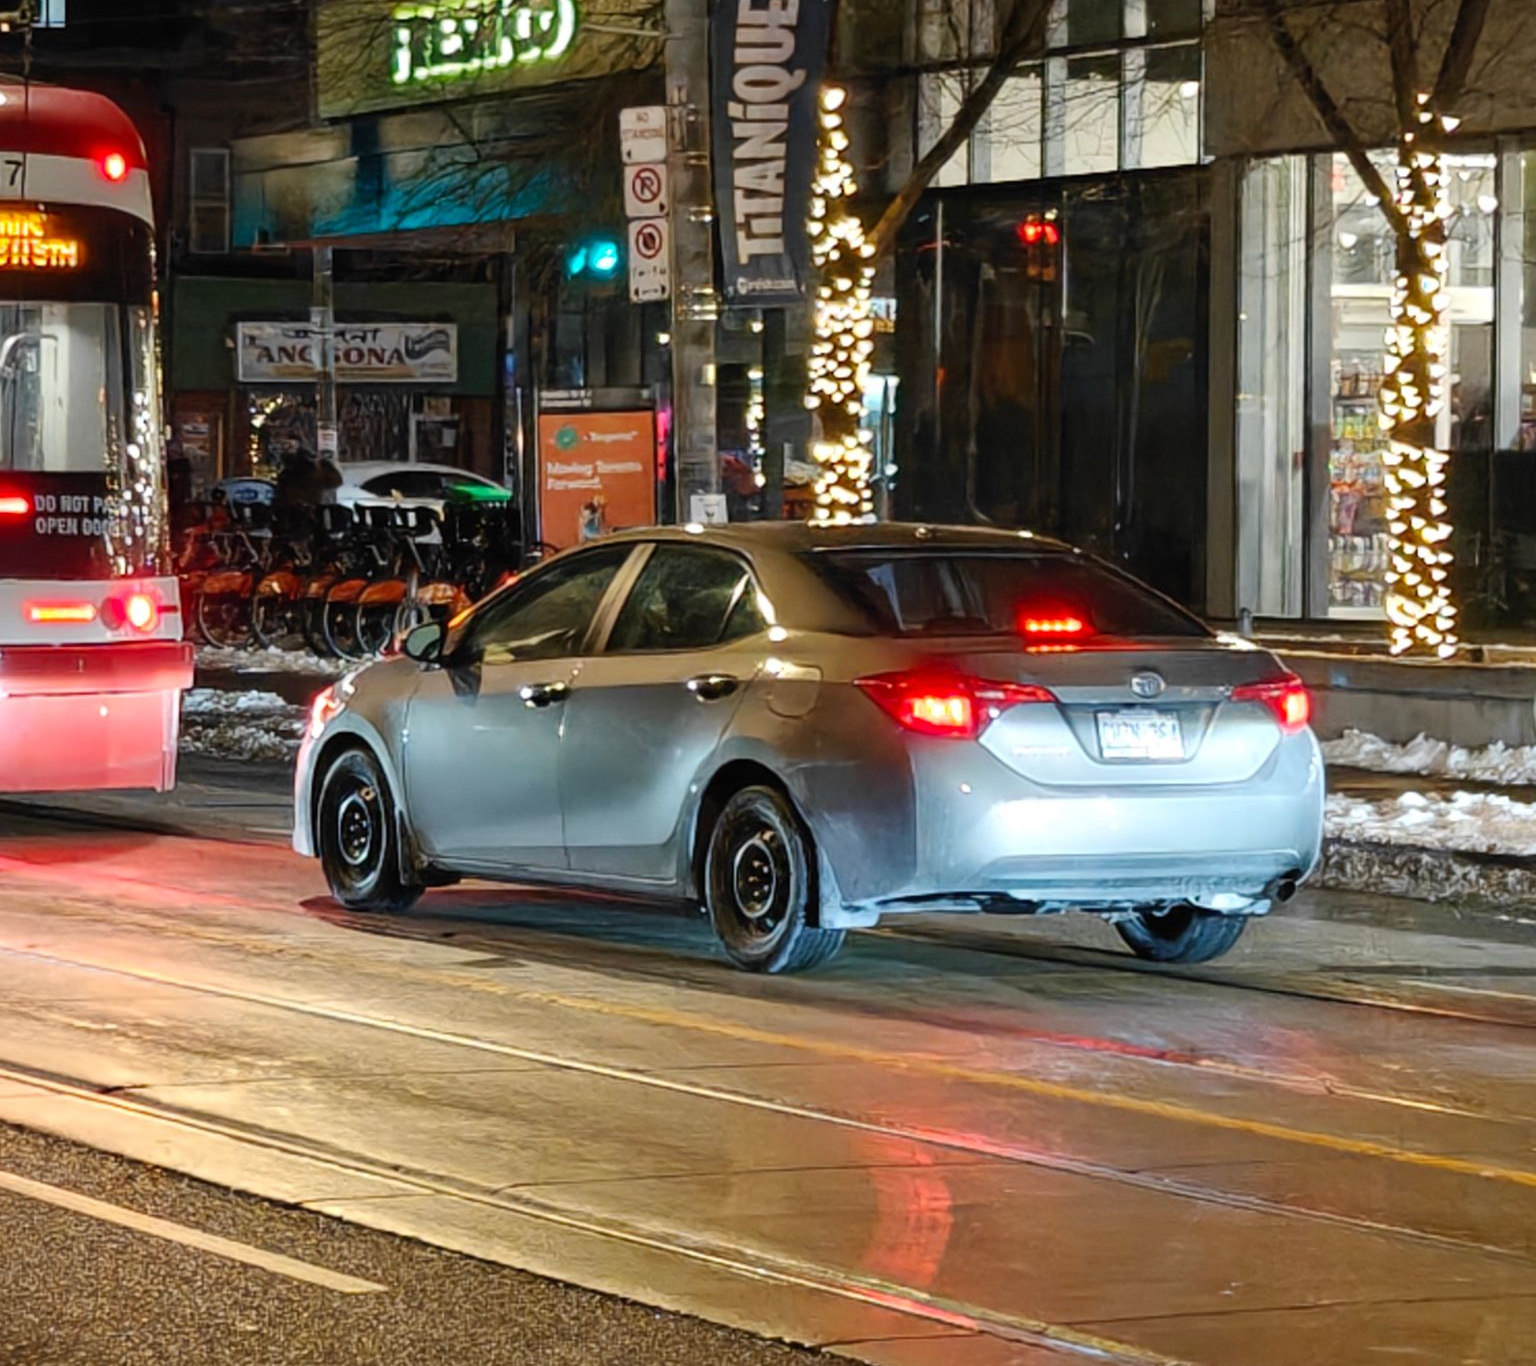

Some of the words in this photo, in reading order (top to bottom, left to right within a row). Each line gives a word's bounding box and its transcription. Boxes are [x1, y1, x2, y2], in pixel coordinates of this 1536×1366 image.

[34, 495, 57, 512] DO
[60, 495, 90, 513] NOT
[35, 517, 78, 535] OPEN
